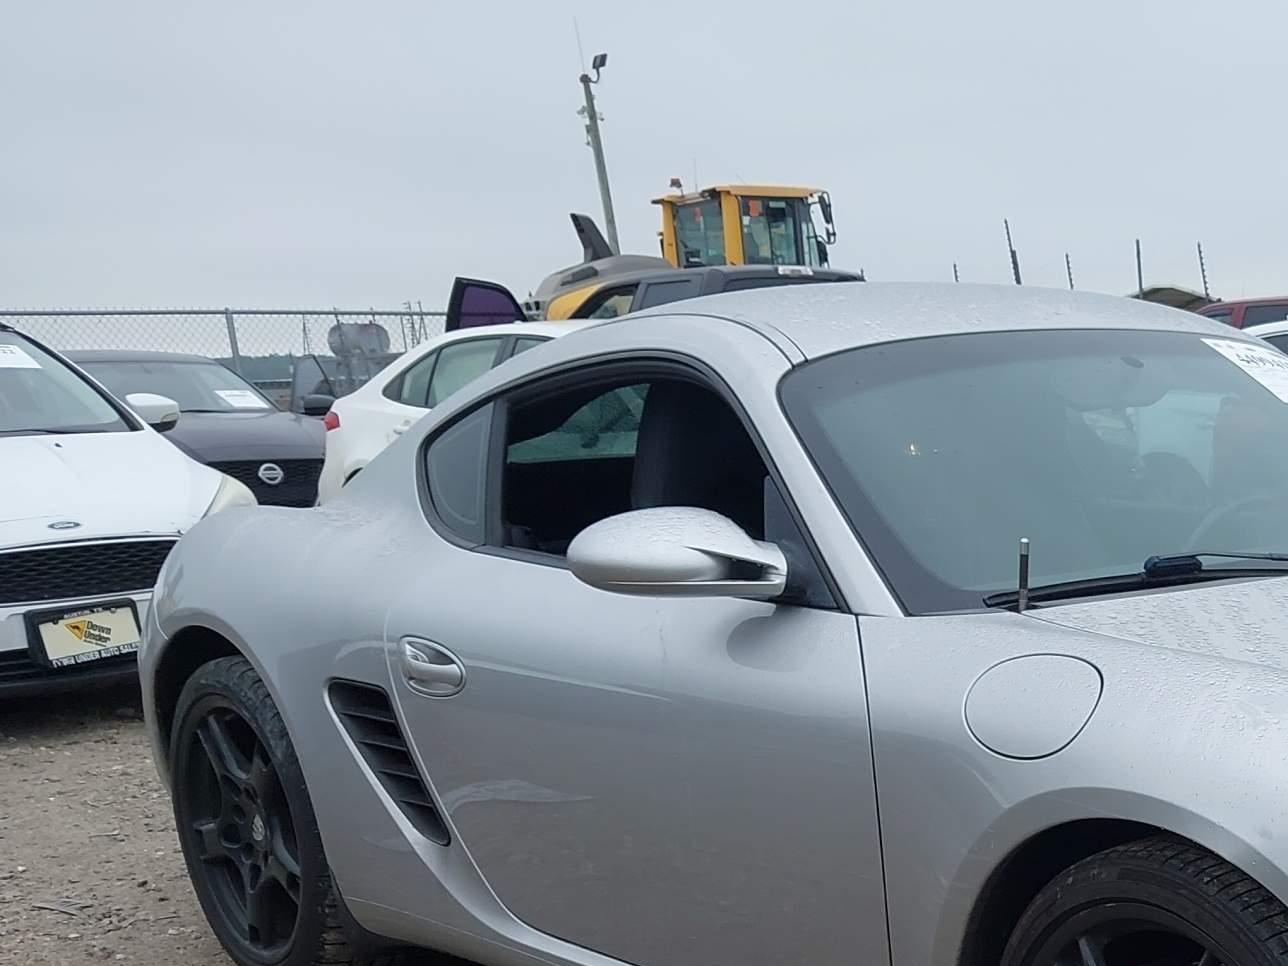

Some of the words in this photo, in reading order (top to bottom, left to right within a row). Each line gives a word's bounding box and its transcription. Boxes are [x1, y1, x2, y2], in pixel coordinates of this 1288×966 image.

[87, 621, 111, 635] Down
[84, 630, 111, 643] Under
[75, 652, 100, 663] UNDER
[101, 647, 120, 657] AUTO
